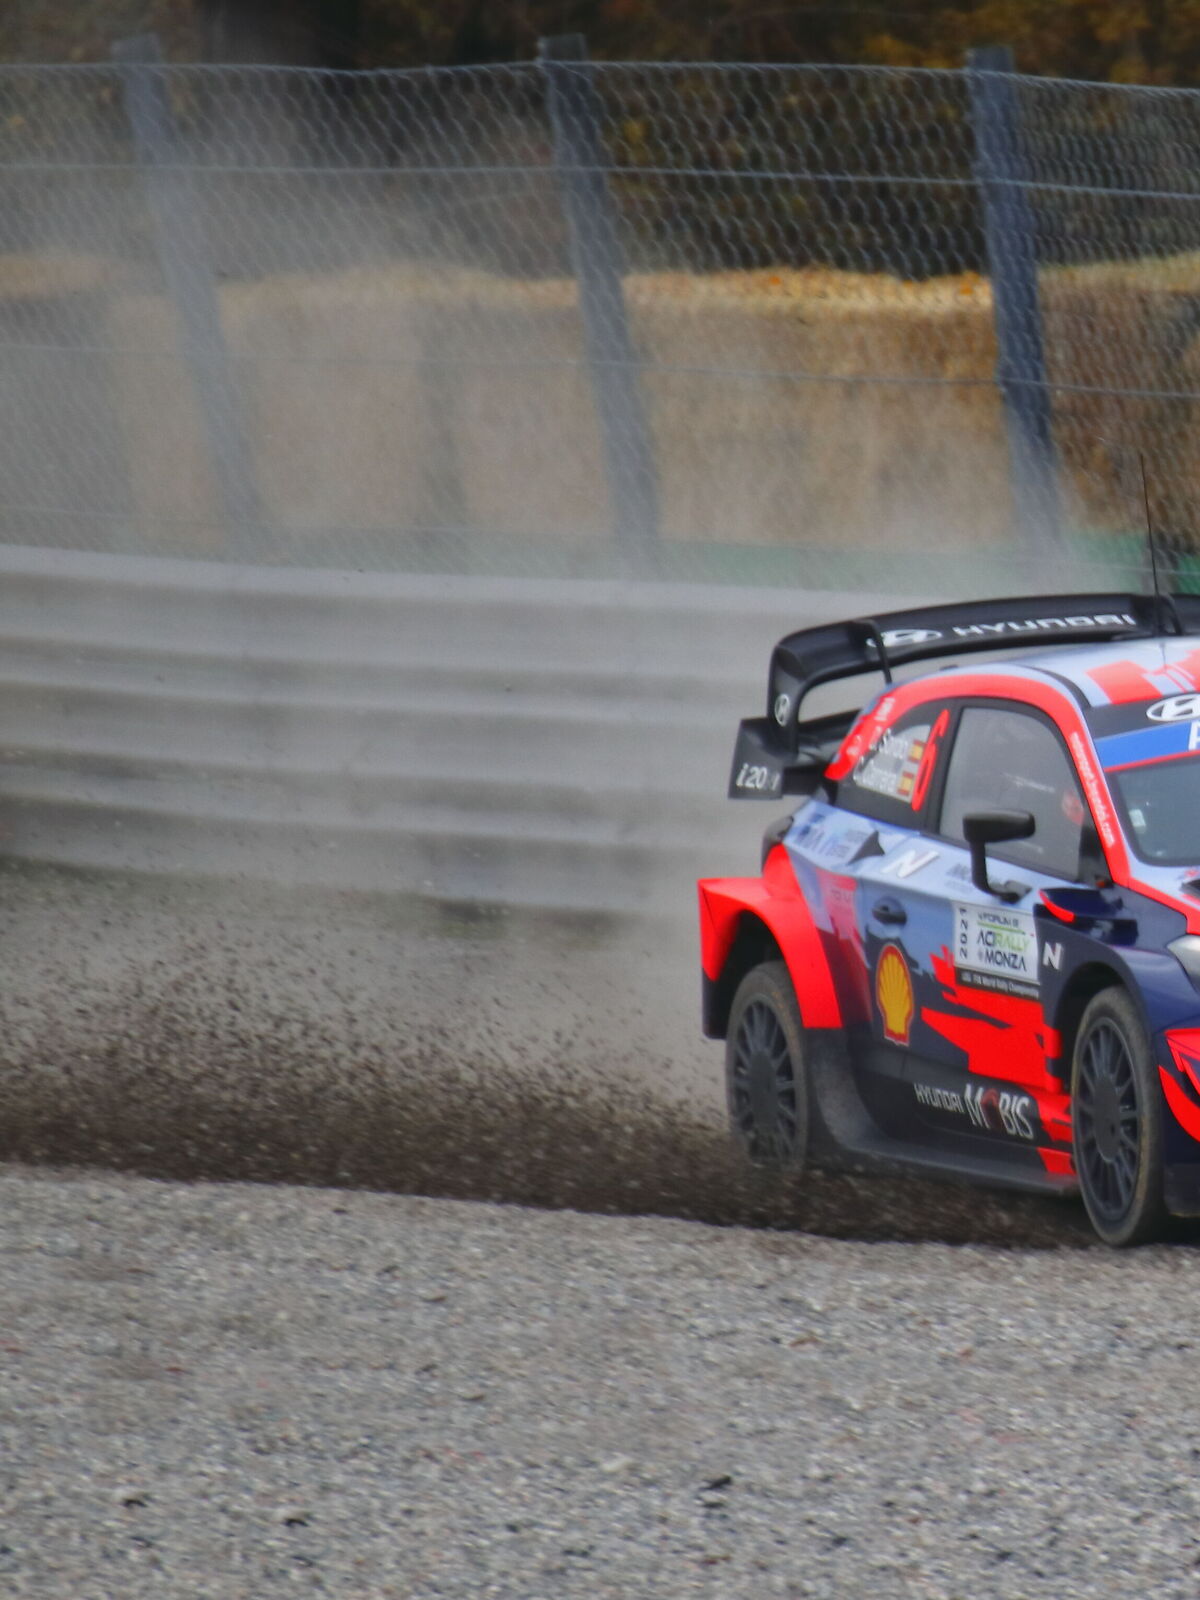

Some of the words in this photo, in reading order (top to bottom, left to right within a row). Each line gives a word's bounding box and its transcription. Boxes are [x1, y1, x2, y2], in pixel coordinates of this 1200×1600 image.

[952, 613, 1137, 637] HYUNDAI
[735, 762, 768, 790] i20
[983, 948, 1028, 973] MONZA
[1041, 939, 1064, 972] N
[913, 1082, 965, 1114] HYUNDAI
[964, 1082, 1035, 1140] MOBIS
